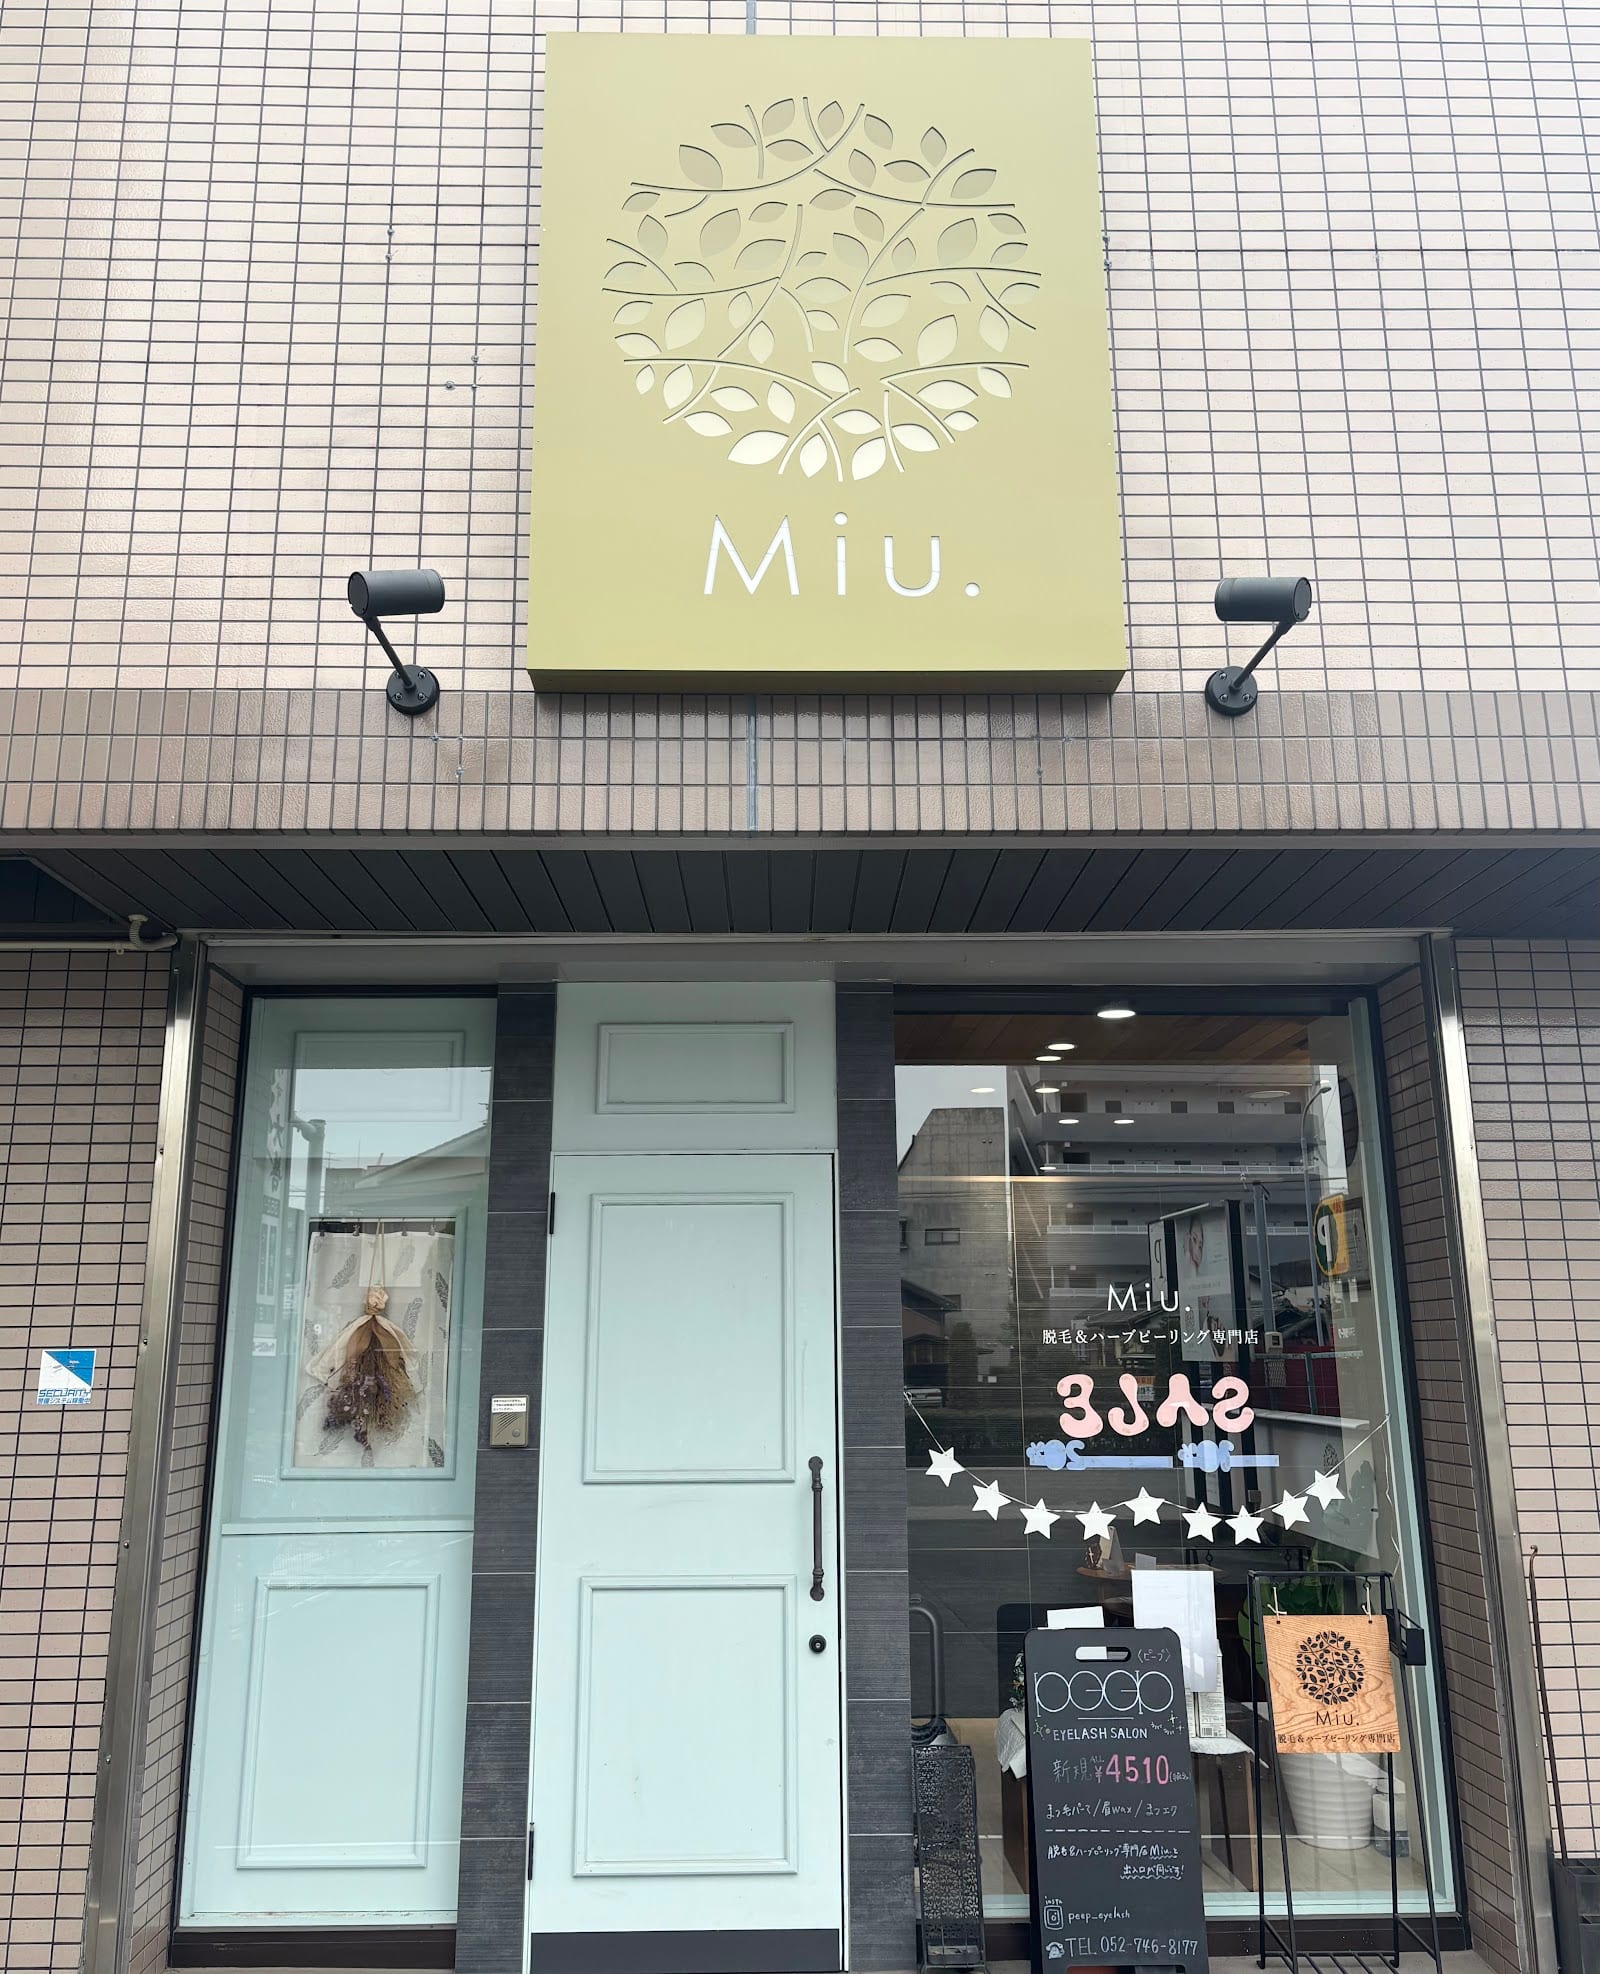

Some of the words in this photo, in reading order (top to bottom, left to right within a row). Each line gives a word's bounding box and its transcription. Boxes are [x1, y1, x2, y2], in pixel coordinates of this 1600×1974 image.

[703, 511, 981, 598] Miu.
[1107, 1282, 1191, 1312] Miu.
[1316, 1709, 1360, 1726] Miu.
[1053, 1728, 1108, 1741] EYELASH
[1110, 1727, 1148, 1739] SALON
[1053, 1757, 1092, 1784] 新規
[1065, 1937, 1097, 1958] TEL
[1100, 1936, 1199, 1956] 052-746-8177
